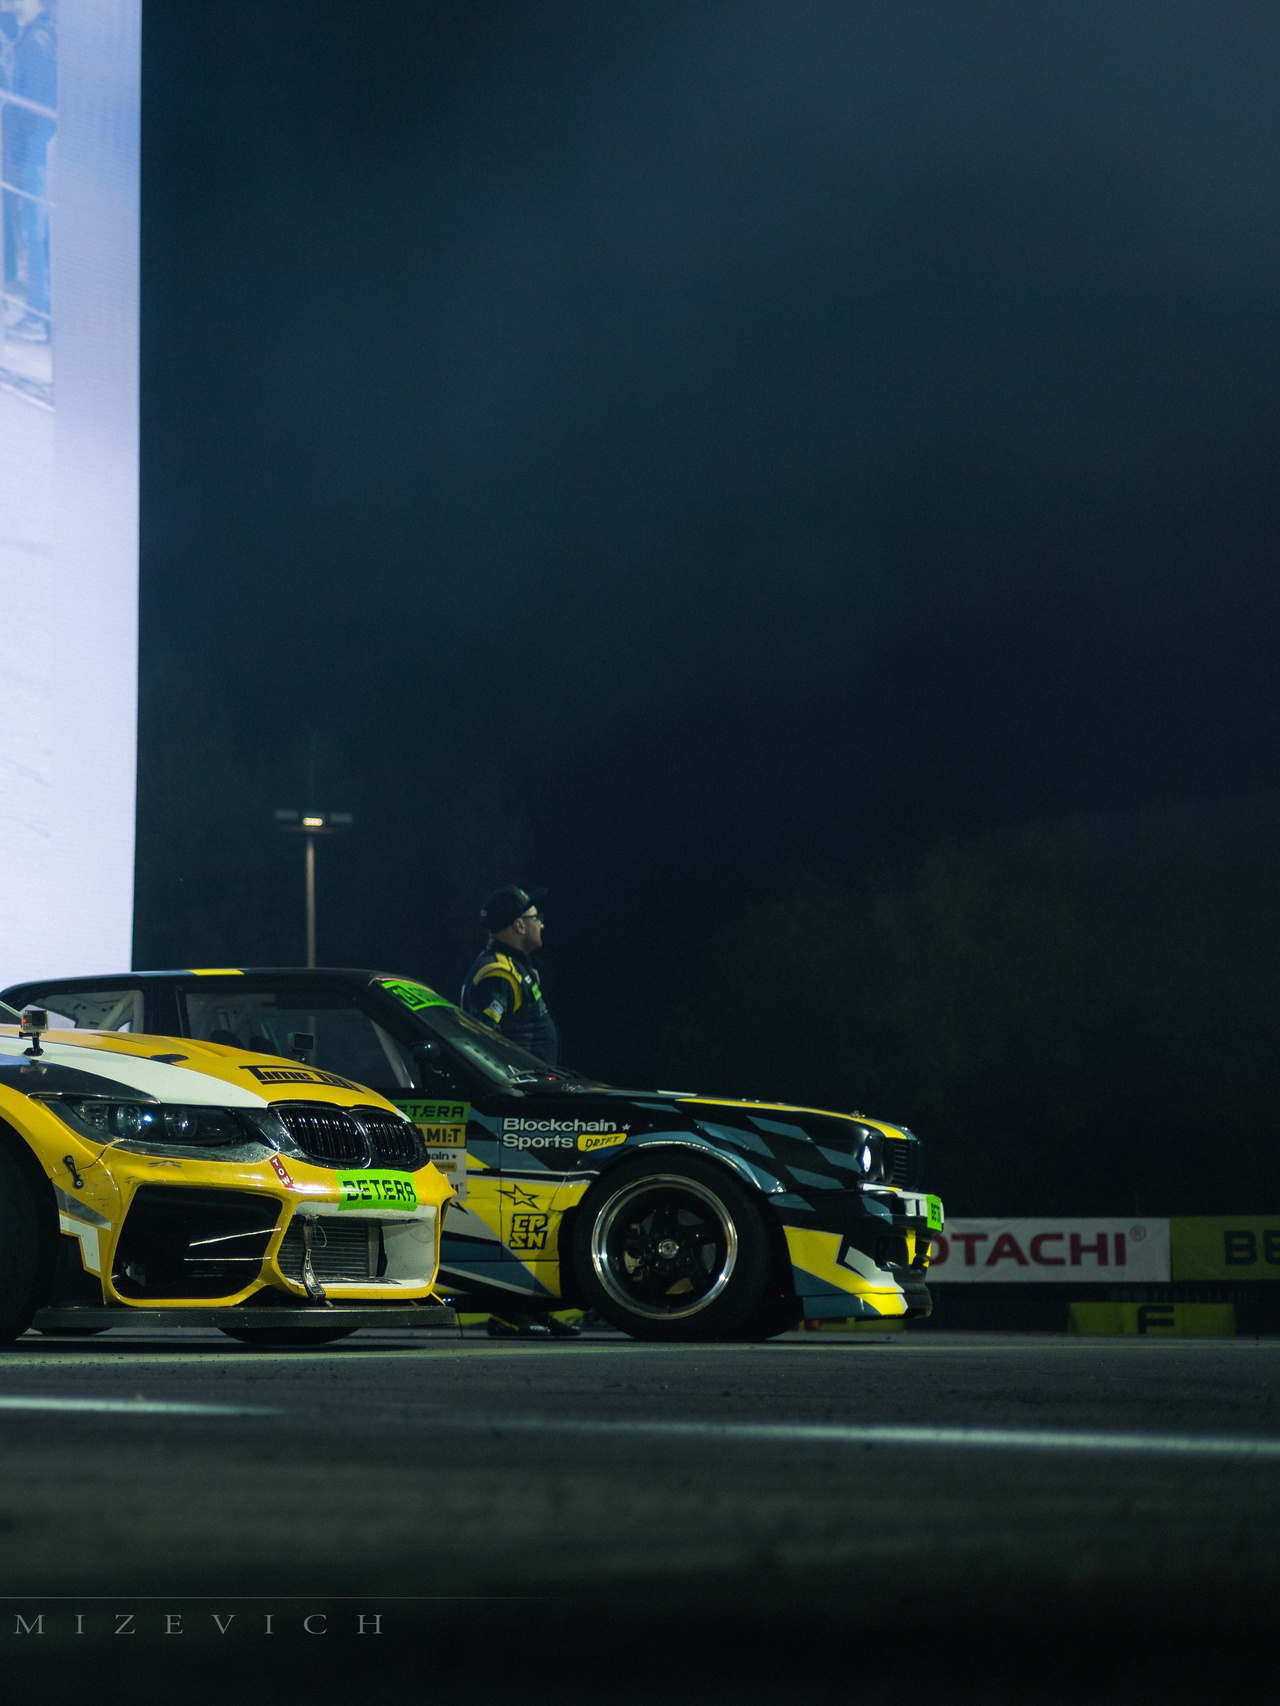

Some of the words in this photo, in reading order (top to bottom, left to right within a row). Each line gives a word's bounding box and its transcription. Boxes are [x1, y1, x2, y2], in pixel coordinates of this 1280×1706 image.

[503, 1117, 618, 1132] Blockchain
[502, 1133, 574, 1151] Sports
[585, 1135, 621, 1150] DRIFT
[271, 1158, 295, 1185] TOW
[929, 1231, 1128, 1267] OTACHI
